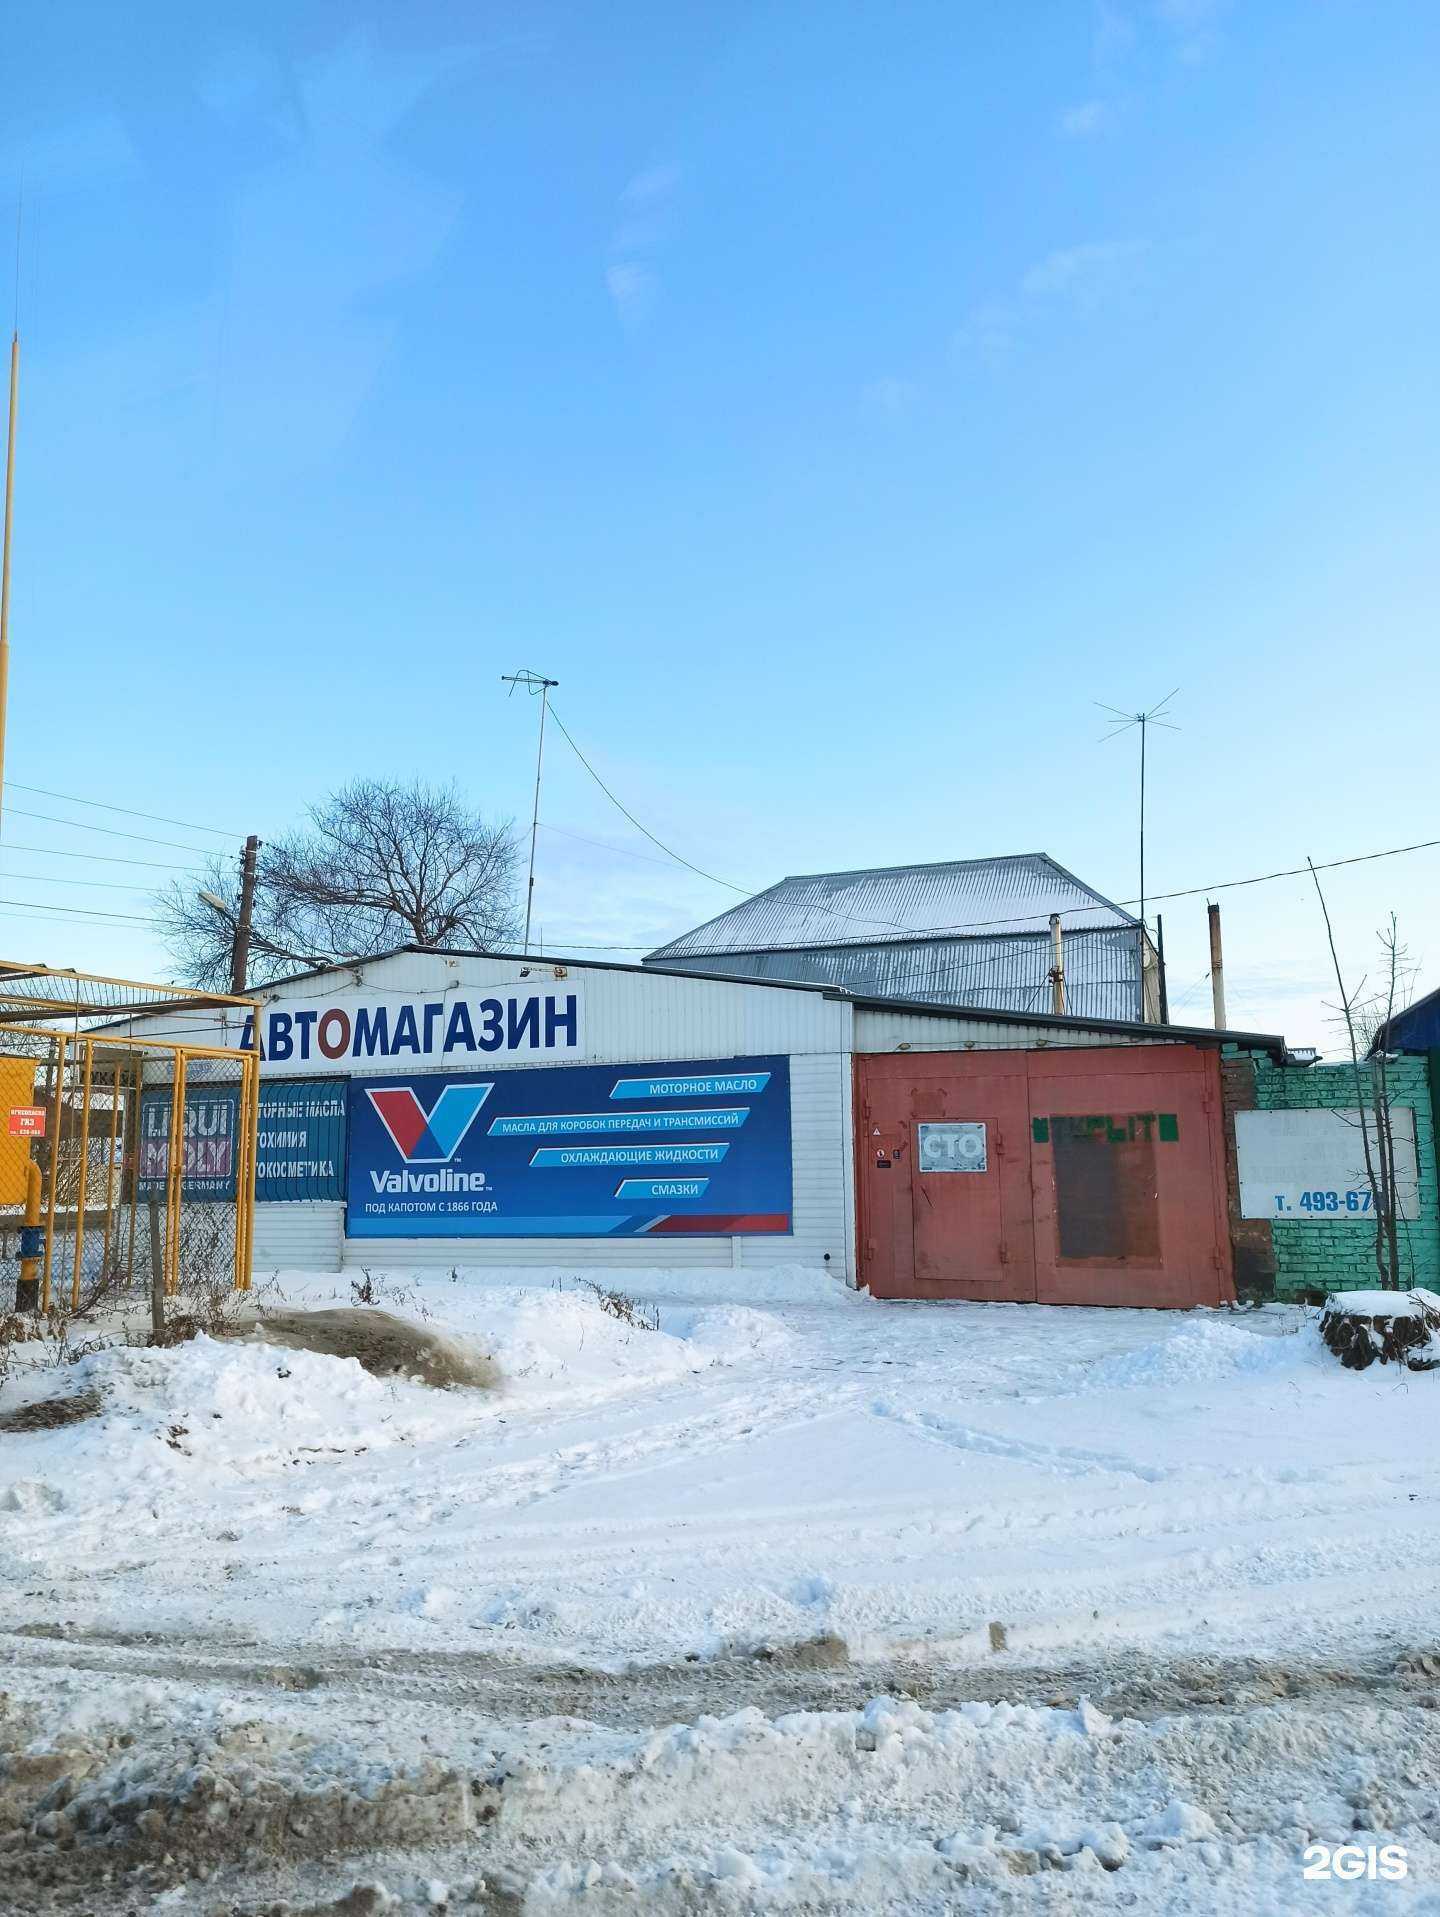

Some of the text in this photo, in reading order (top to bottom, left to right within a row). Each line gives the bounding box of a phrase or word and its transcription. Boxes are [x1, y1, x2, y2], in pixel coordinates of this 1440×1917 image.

[239, 994, 577, 1063] АВТОМАГАЗИН
[650, 1079, 757, 1094] МОТОРНОЕ МАСЛО
[239, 1100, 345, 1118] ТОРНЫЕ МАСЛА
[502, 1112, 739, 1133] МАСЛА ДЛЯ КОРОБОК ПЕРЕДАЧ И ТРАНСМИССИЙ
[237, 1131, 307, 1149] ОХИМИЯ
[924, 1134, 982, 1158] СТО
[561, 1149, 718, 1163] ОХЛАЖДАЮЩИЕ ЖИДКОСТИ
[236, 1161, 334, 1178] ОКОСМЕТИКА
[369, 1169, 486, 1193] Valvoline
[651, 1185, 698, 1195] СМАЗКИ
[365, 1201, 498, 1214] ПОД КАПОТОМ С 1866 ГОДА
[1300, 1191, 1388, 1212] 493-67
